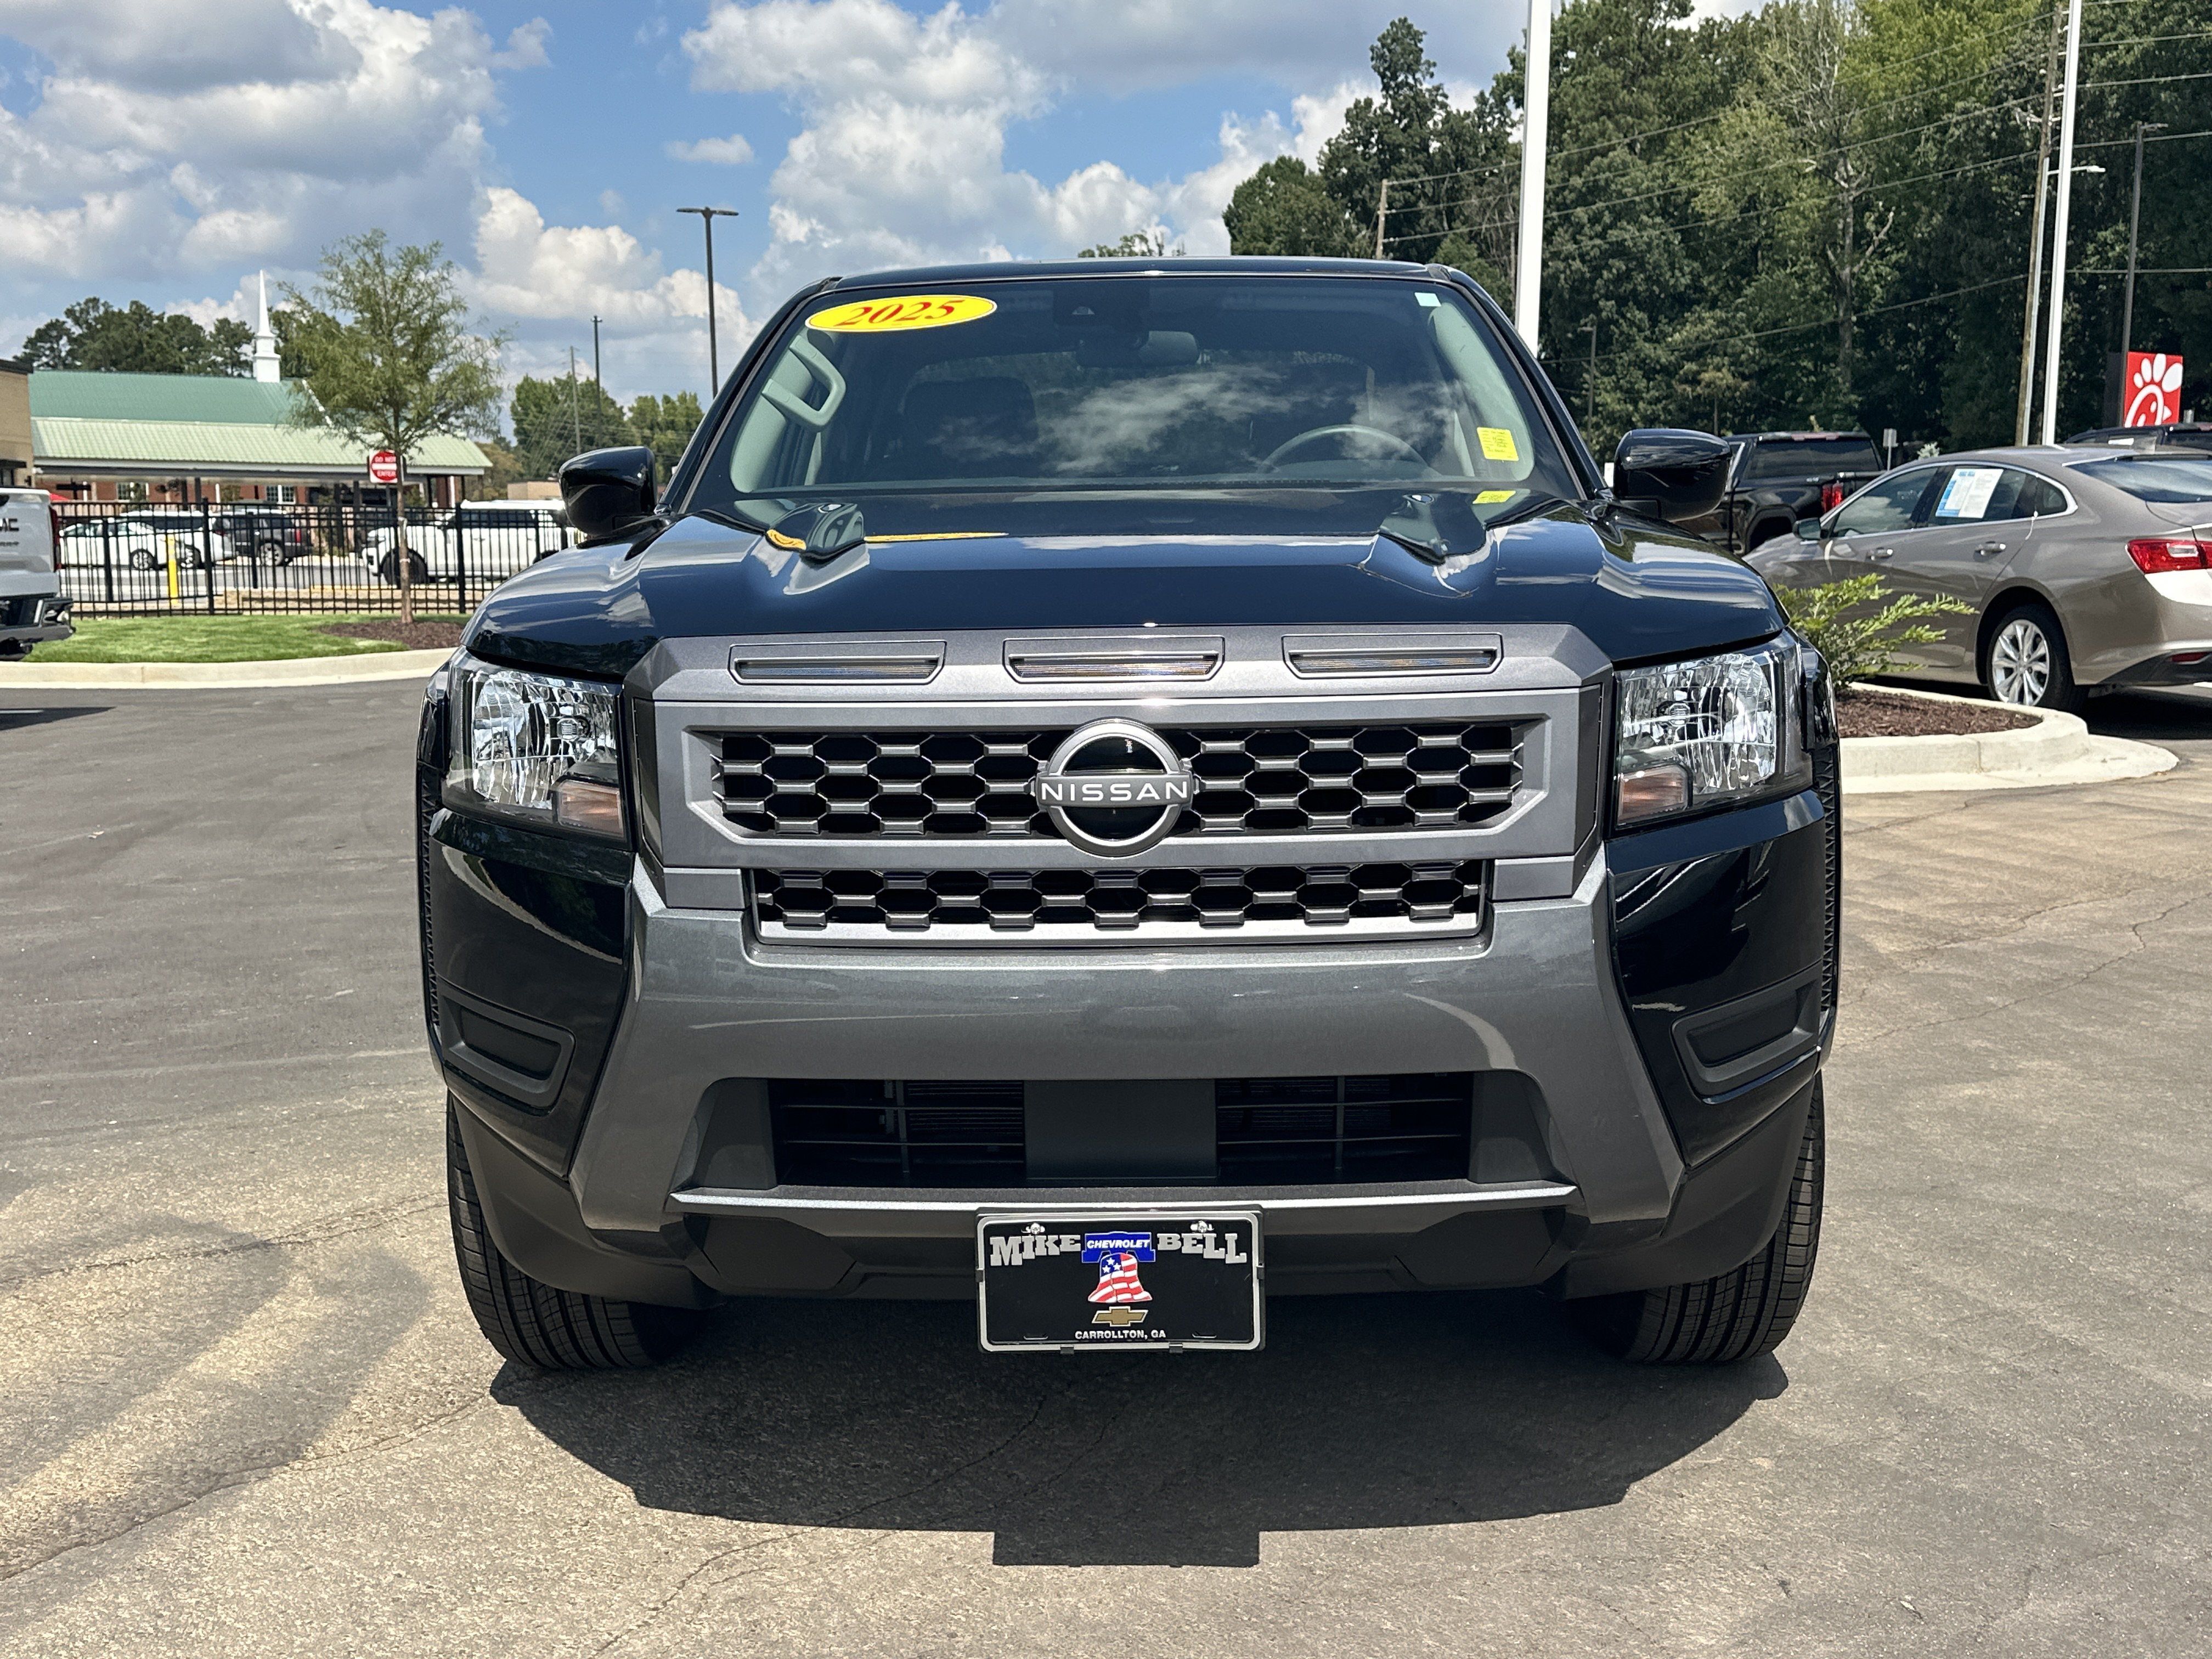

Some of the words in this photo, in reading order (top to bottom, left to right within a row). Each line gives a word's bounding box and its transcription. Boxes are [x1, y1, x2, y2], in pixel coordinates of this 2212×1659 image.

[833, 299, 966, 327] 2025
[1041, 781, 1188, 801] NISSAN
[990, 1234, 1081, 1266] MIKE
[1086, 1239, 1151, 1249] CHEVROLET
[1157, 1233, 1247, 1264] BELL
[1075, 1330, 1148, 1340] CARROLLTON,
[1150, 1330, 1166, 1339] GA
